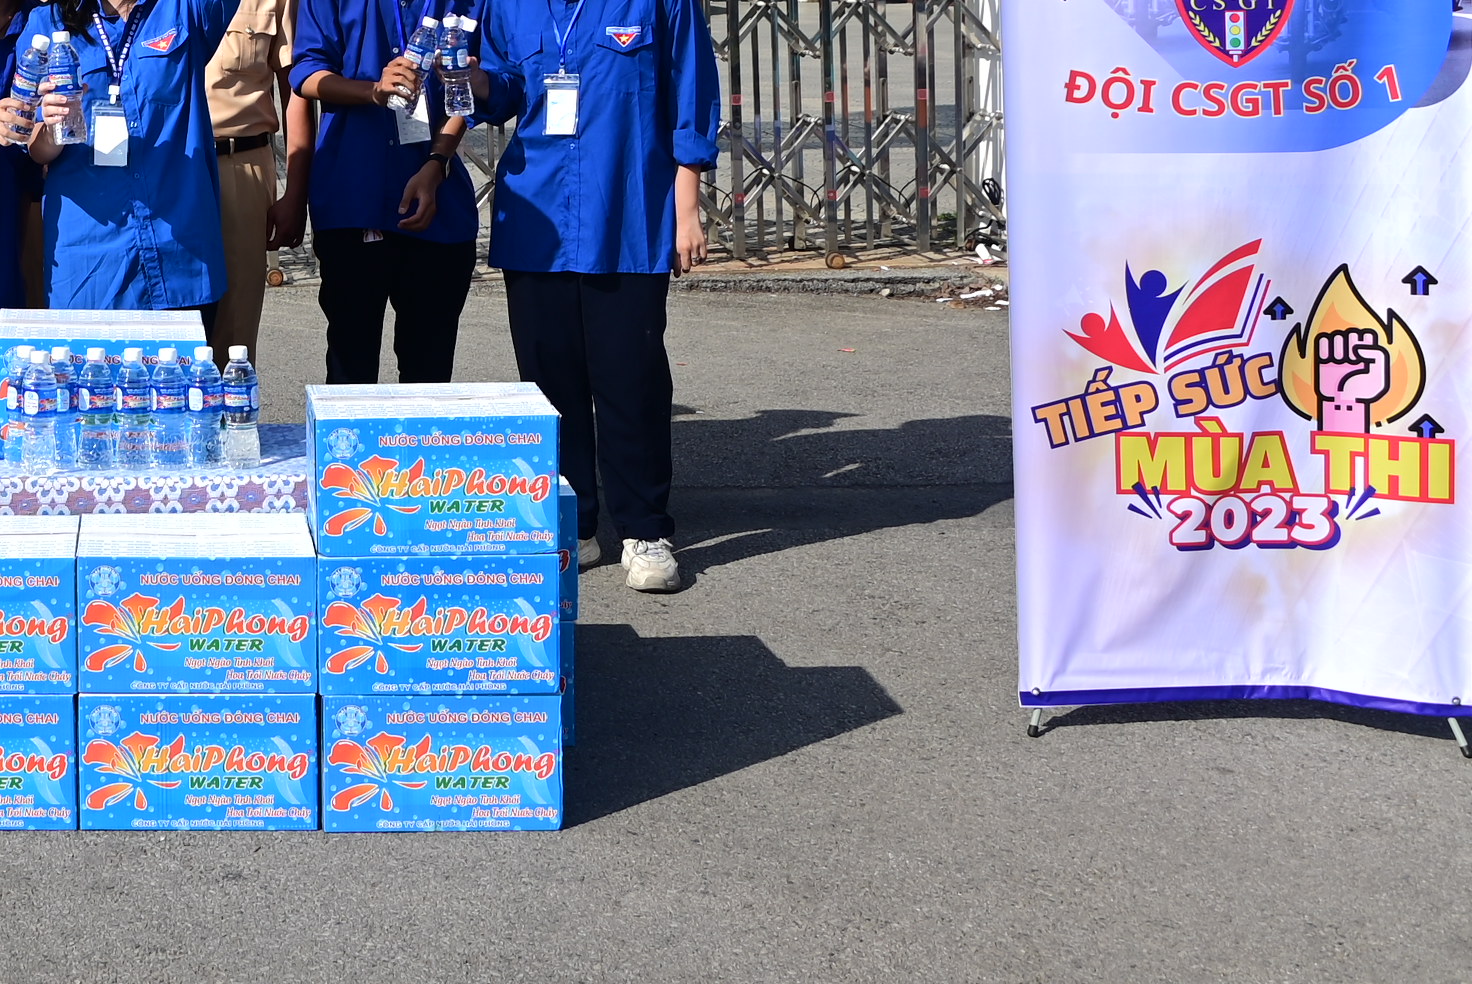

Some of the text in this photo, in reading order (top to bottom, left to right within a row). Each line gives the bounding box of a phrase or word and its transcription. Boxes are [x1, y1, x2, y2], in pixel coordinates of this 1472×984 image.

[1064, 60, 1402, 119] ĐỘI CSGT SỐ 1
[1031, 350, 1280, 449] TIẾP SỨC
[379, 431, 542, 447] NƯỚC UỐNG ĐÓNG CHAI
[1116, 416, 1456, 504] MÙA THI
[377, 464, 550, 505] HaiPhong
[429, 499, 505, 514] WATER
[1167, 492, 1339, 550] 2023
[26, 576, 60, 587] CHAI
[140, 571, 301, 586] NƯỚC UỐNG ĐÓNG CHAI
[138, 605, 308, 642] HaiPhong
[380, 604, 551, 643] HaiPhong
[188, 638, 264, 651] WATER
[430, 638, 507, 652] WATER
[26, 713, 59, 724] CHAI
[387, 709, 547, 724] NƯỚC UỐNG ĐÓNG CHAI
[138, 743, 308, 780] HaiPhong
[384, 742, 555, 780] HaiPhong
[189, 776, 264, 789] WATER
[435, 776, 510, 790] WATER
